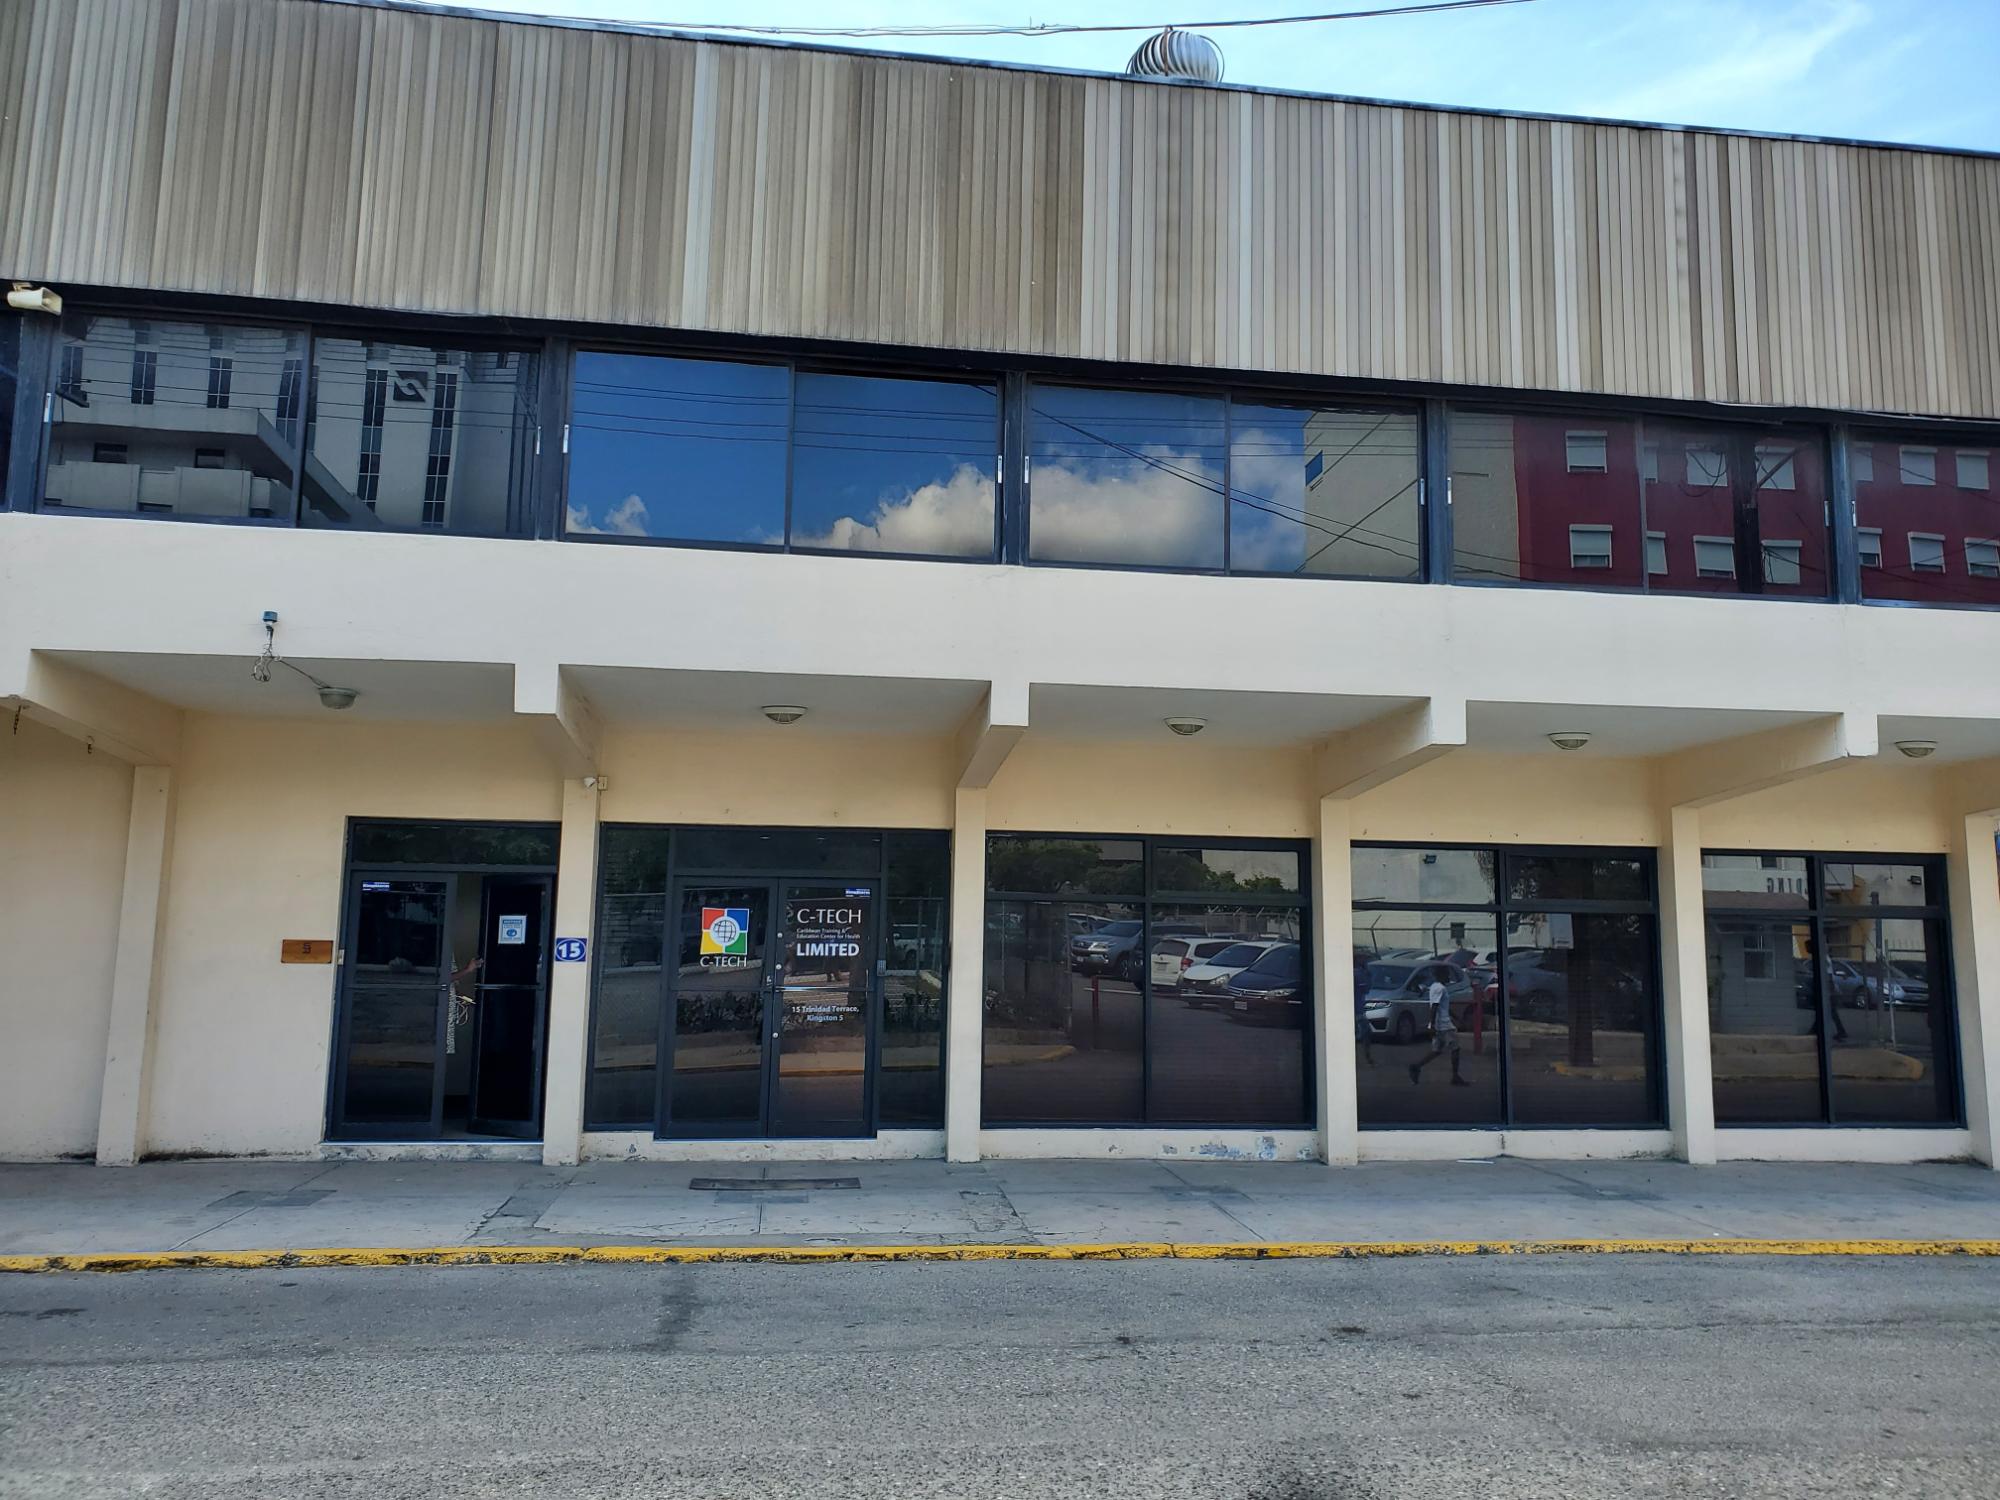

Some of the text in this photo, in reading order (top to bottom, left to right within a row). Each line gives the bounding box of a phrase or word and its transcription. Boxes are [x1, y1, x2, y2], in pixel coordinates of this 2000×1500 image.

[796, 908, 862, 924] C-TECH
[558, 942, 581, 958] 15
[796, 943, 860, 956] LIMITED
[699, 956, 747, 967] C-TECH
[802, 1005, 831, 1013] Trinidad
[806, 1014, 838, 1022] Kingston
